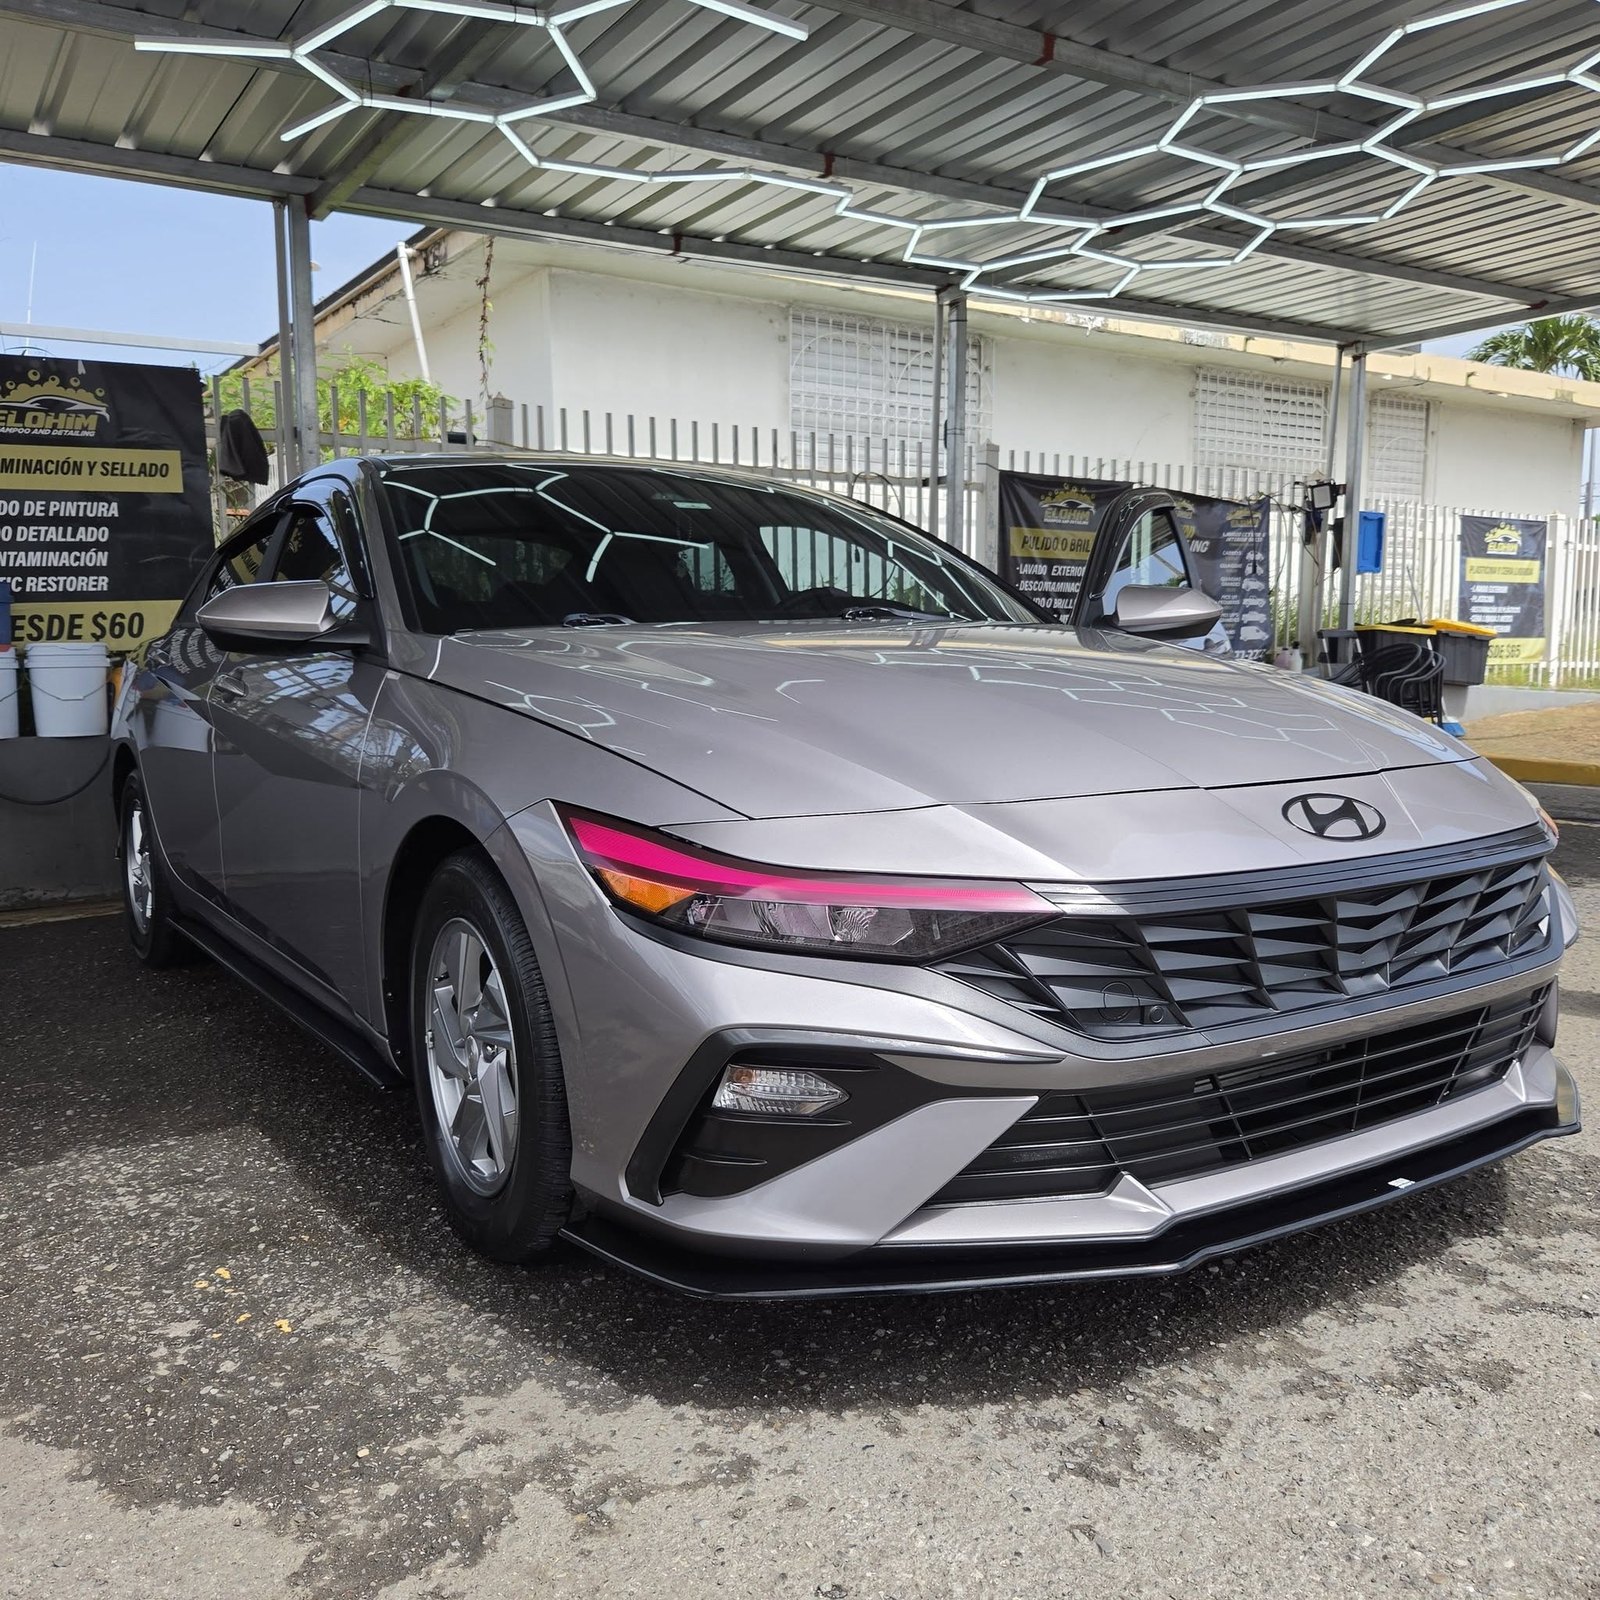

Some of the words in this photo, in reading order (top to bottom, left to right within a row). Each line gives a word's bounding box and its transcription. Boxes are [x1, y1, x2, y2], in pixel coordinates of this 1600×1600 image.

[52, 429, 96, 437] DETAILING
[88, 461, 97, 476] Y
[100, 461, 169, 477] SELLADO
[23, 500, 46, 517] DE
[48, 501, 119, 517] PINTURA
[16, 526, 109, 542] DETALLADO
[1021, 535, 1059, 551] PULIDO
[1061, 538, 1068, 551] O
[25, 576, 109, 592] RESTORER
[91, 611, 144, 641] $60
